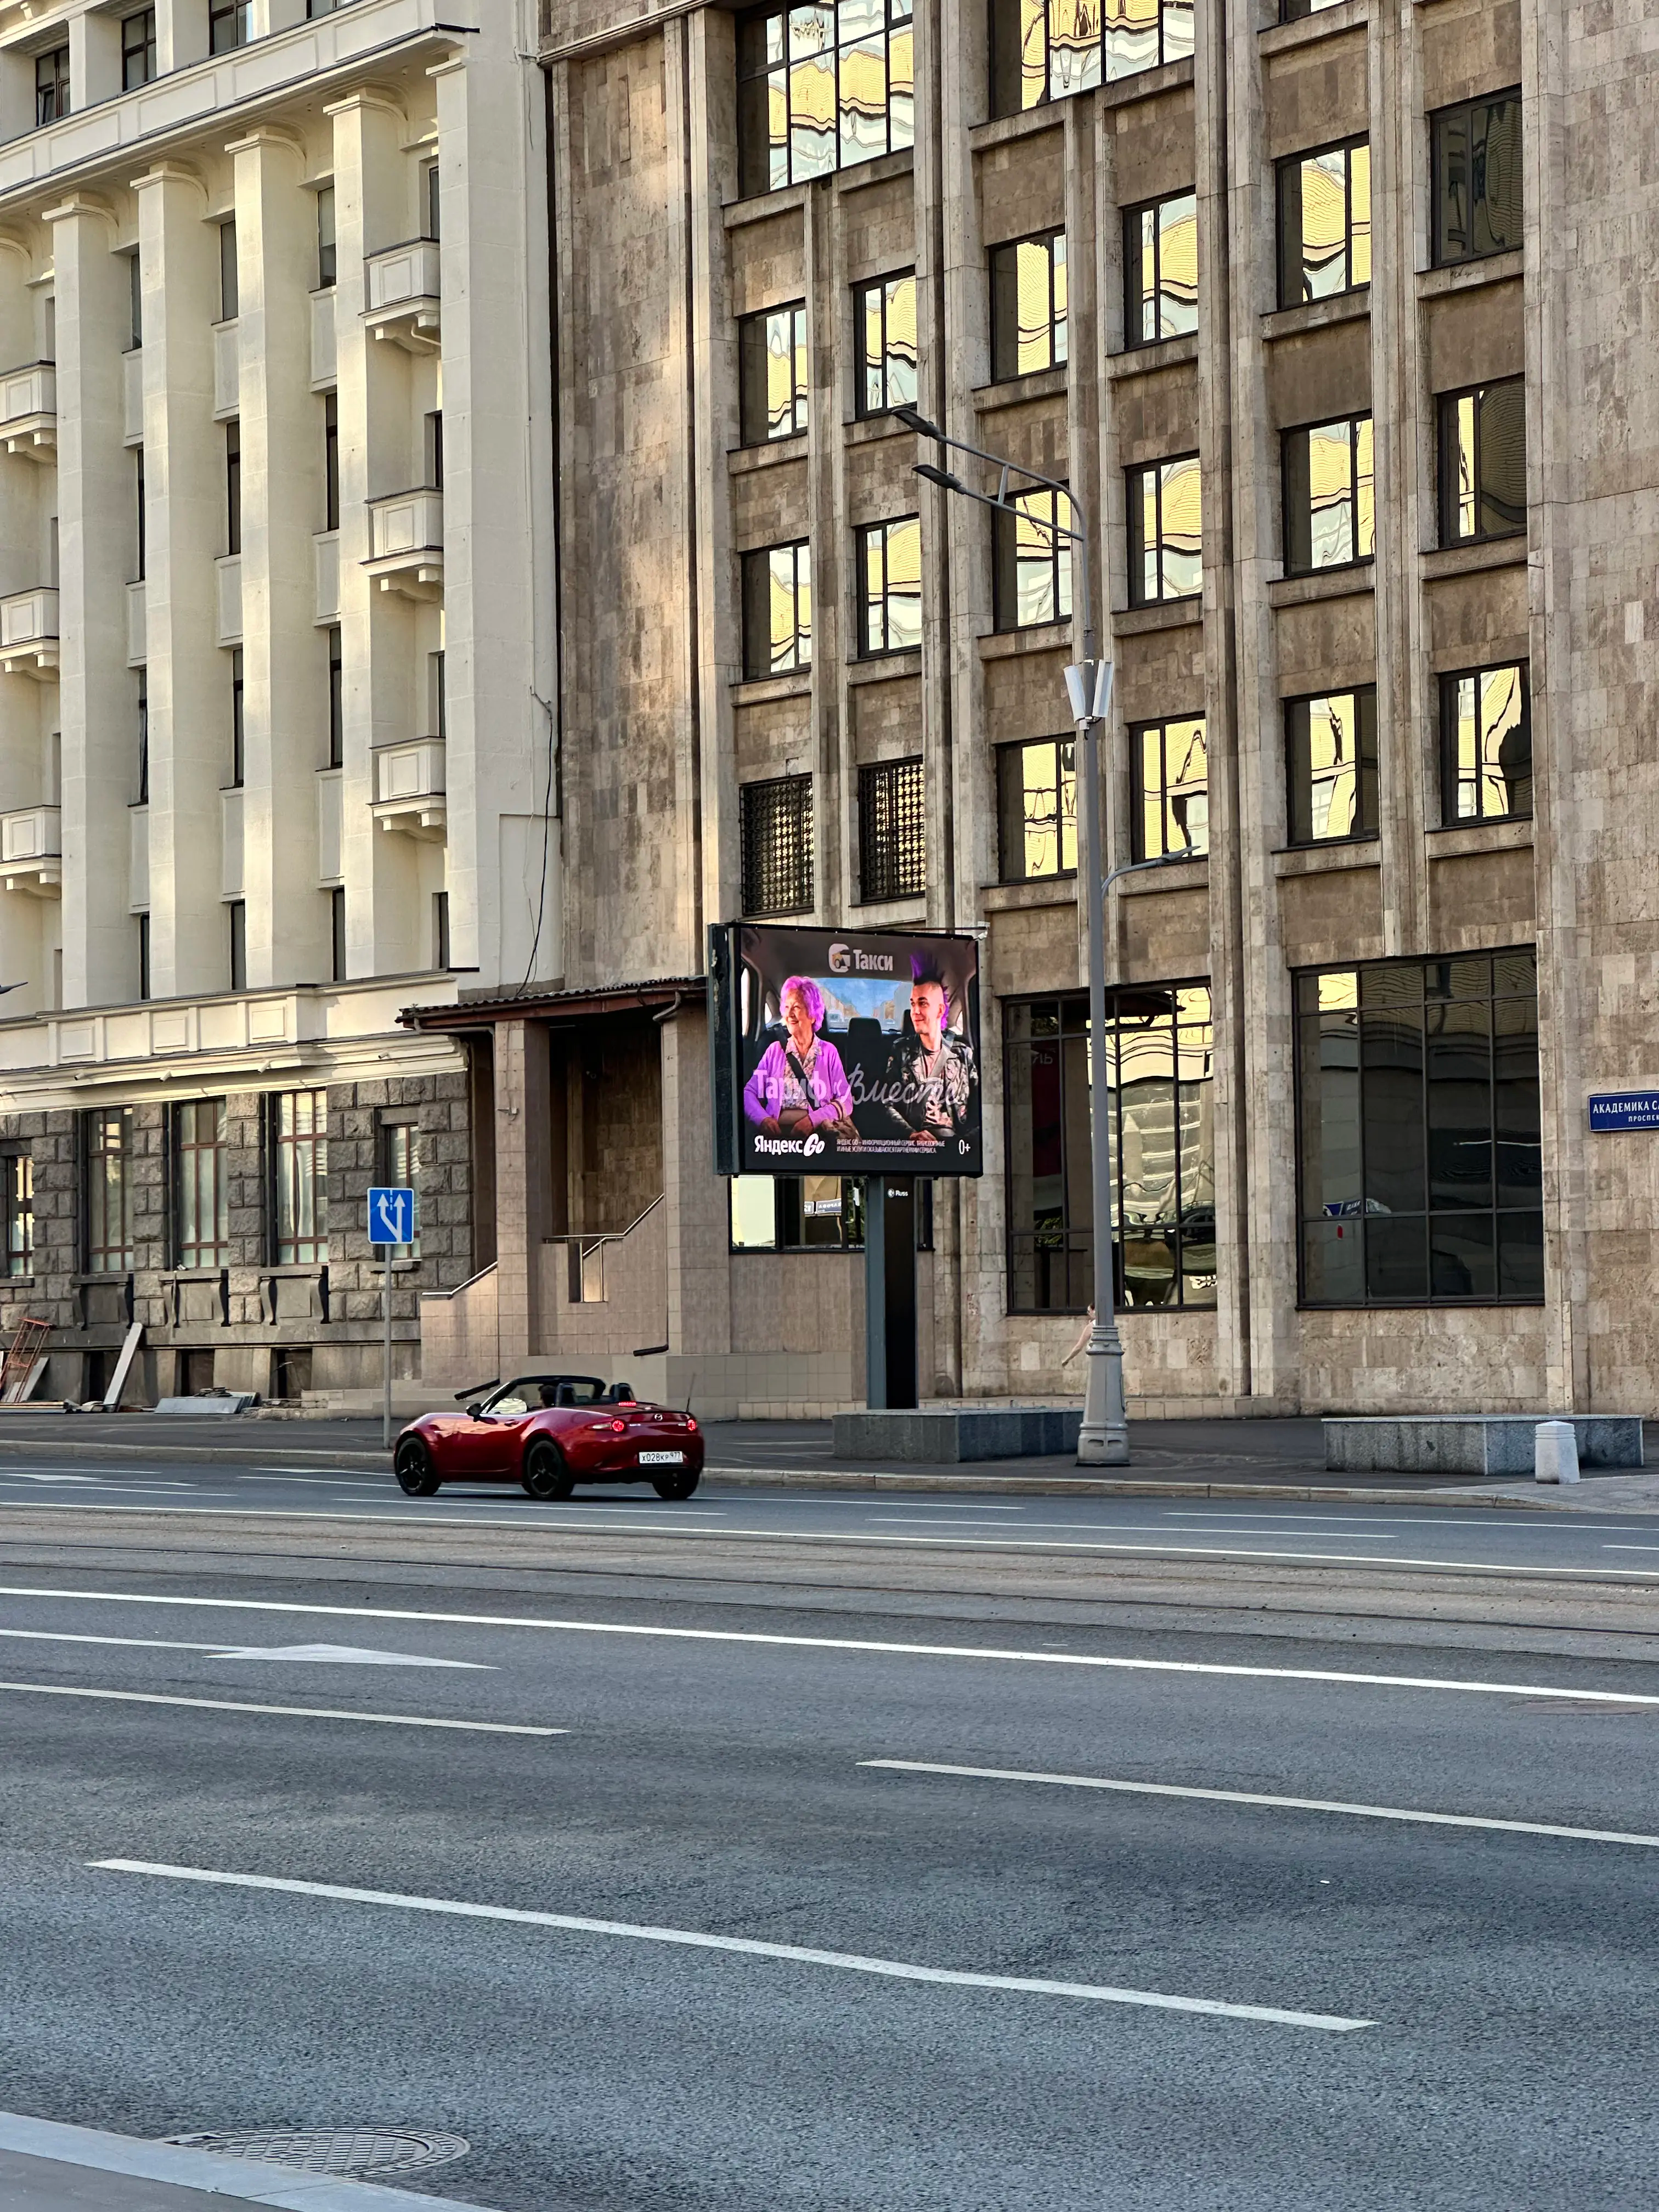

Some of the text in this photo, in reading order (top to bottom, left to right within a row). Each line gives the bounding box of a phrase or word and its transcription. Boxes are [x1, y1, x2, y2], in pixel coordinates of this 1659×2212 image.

[853, 949, 893, 971] Такси
[754, 1070, 827, 1107] Тариф
[1593, 1101, 1650, 1114] АКАДЕМИКА
[754, 1133, 825, 1156] Яндекс Go
[958, 1139, 971, 1155] 0+
